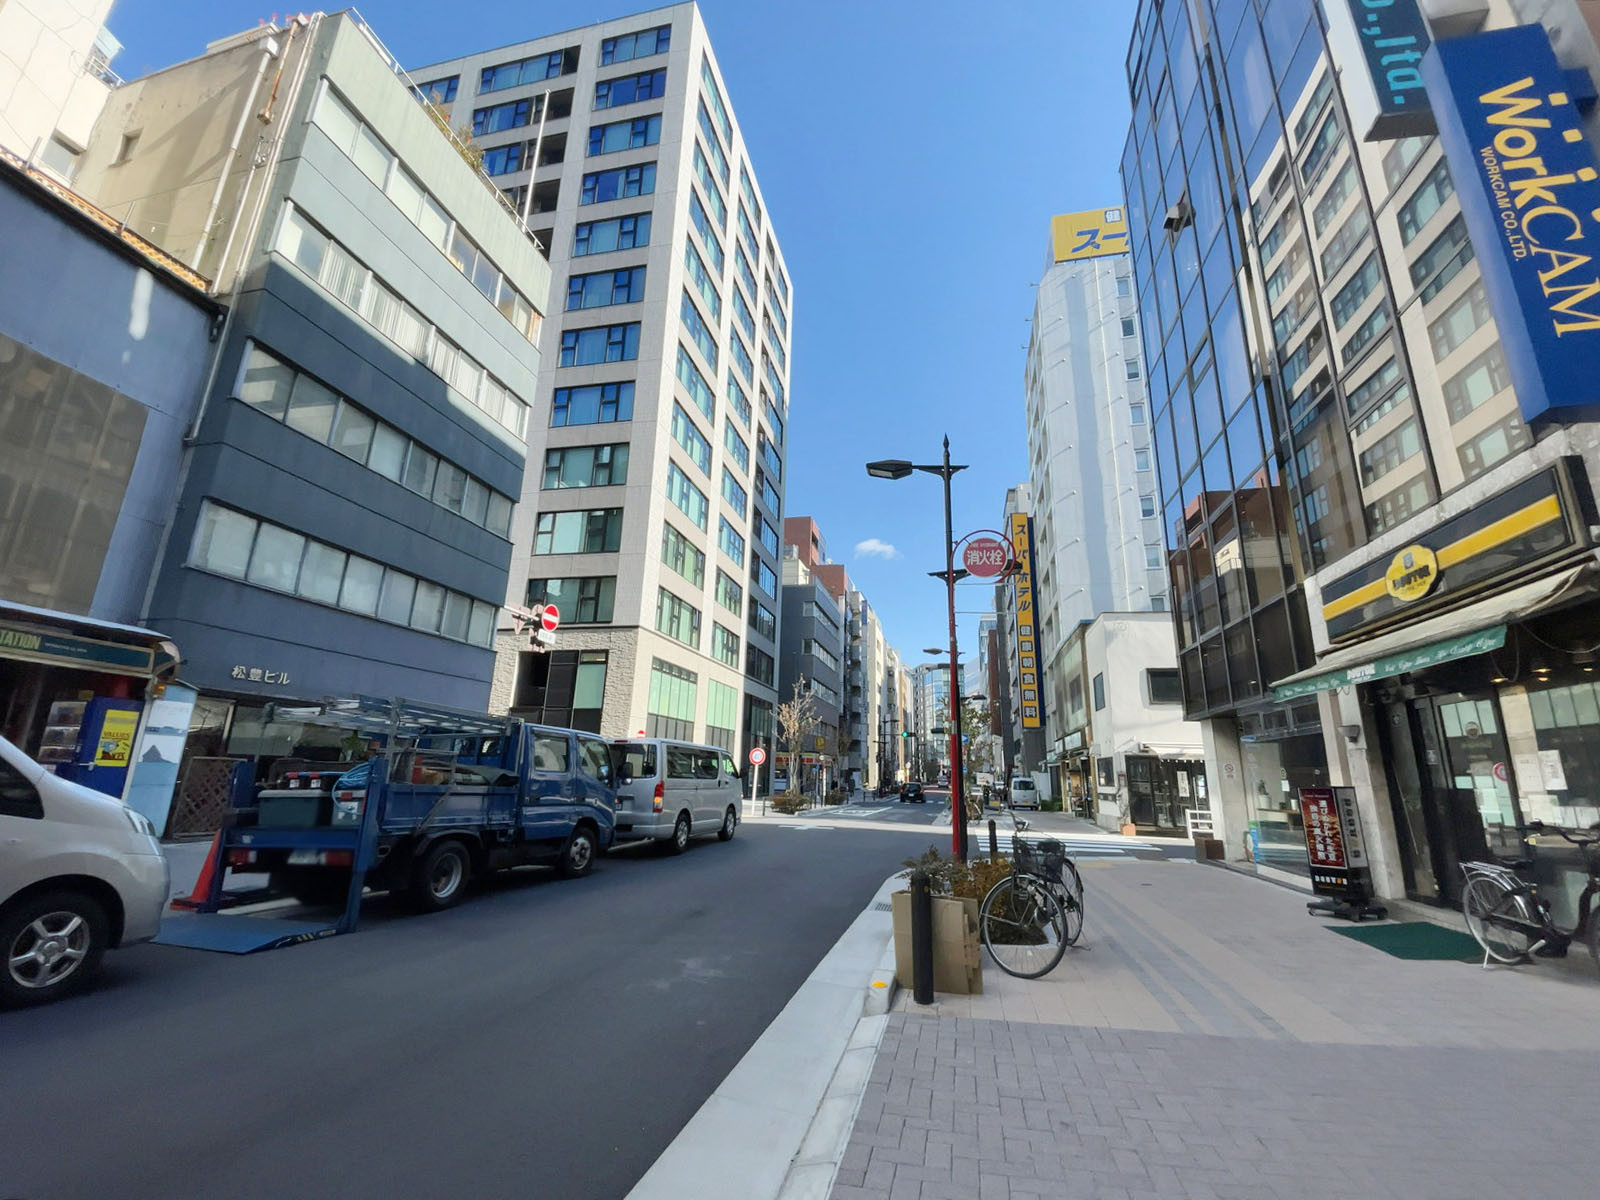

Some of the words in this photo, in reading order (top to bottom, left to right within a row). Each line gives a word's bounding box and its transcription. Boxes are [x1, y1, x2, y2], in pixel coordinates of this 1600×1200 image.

[1480, 146, 1511, 207] WORKCAM
[1501, 211, 1527, 262] CO.,LTD.
[967, 549, 1003, 565] 消火栓
[231, 664, 290, 685] 松豊ビル
